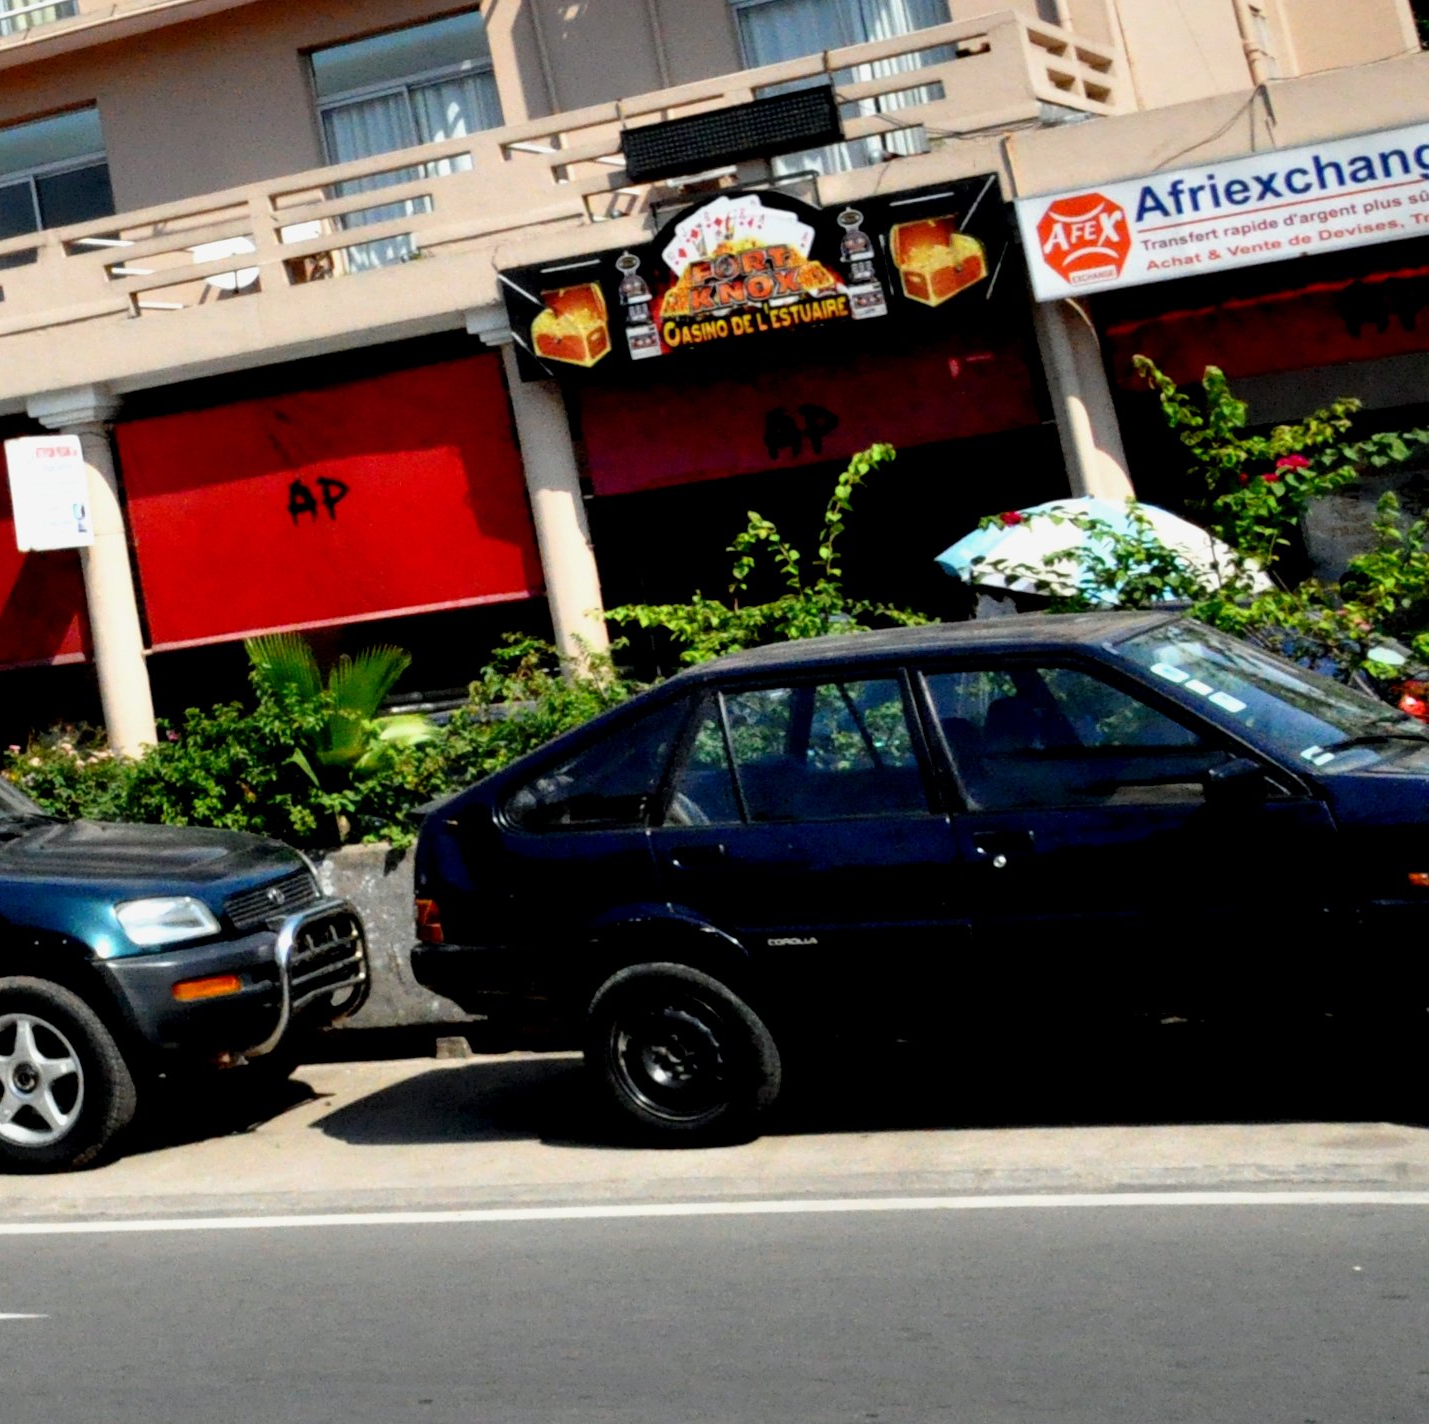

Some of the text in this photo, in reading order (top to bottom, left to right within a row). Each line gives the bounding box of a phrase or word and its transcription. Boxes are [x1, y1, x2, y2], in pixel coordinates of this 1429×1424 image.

[1043, 210, 1122, 254] AFEX
[1141, 229, 1219, 251] Transfert
[1224, 219, 1278, 238] rapide
[1283, 204, 1357, 227] d'argent
[1363, 198, 1402, 215] plus
[691, 244, 792, 286] FORT
[1146, 250, 1202, 271] Achat
[1208, 249, 1221, 262] &
[1227, 238, 1282, 257] Vente
[1288, 232, 1312, 247] de
[691, 269, 800, 314] KNOX
[663, 295, 849, 347] CASINO DE L'ESTUAIRE
[764, 402, 839, 459] AP
[288, 476, 348, 524] AP
